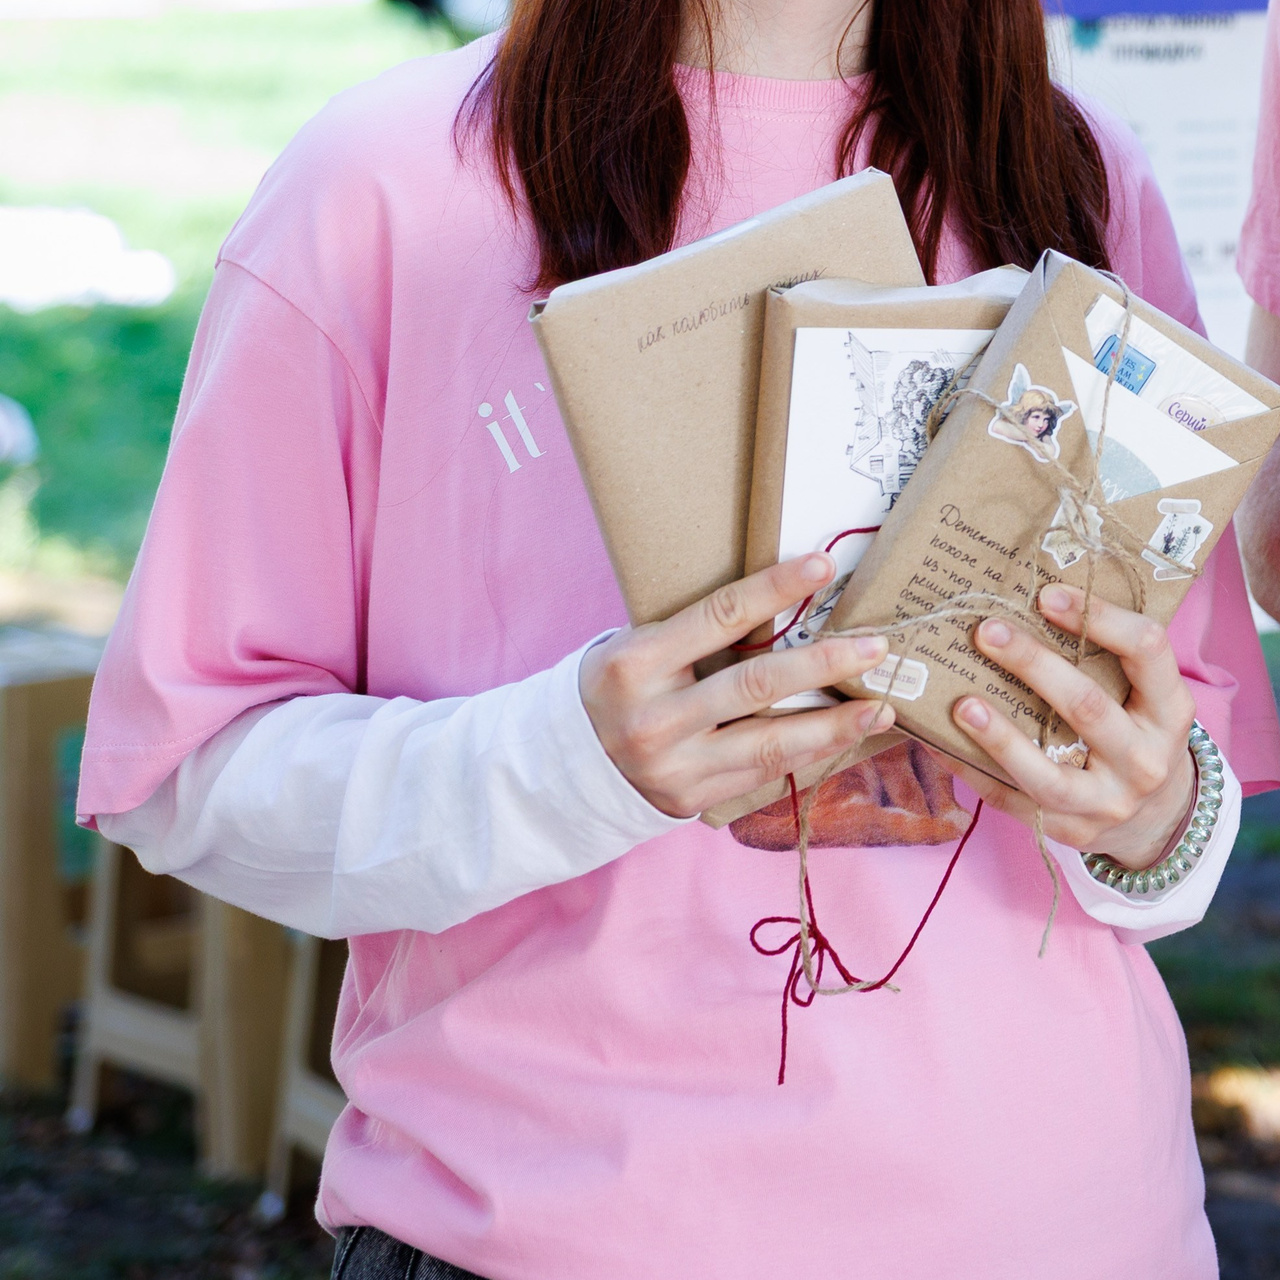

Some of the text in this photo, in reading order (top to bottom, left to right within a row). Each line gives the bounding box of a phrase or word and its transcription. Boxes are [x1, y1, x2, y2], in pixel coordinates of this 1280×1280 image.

[1100, 365, 1136, 393] HOKED
[1117, 367, 1132, 380] AM
[1167, 401, 1207, 432] Серий
[940, 504, 1022, 567] Детектив,
[922, 555, 973, 596] из-под
[982, 566, 1003, 583] на
[873, 666, 917, 686] MEMRIES
[915, 644, 978, 684] лишних
[946, 637, 1034, 696] рассказать
